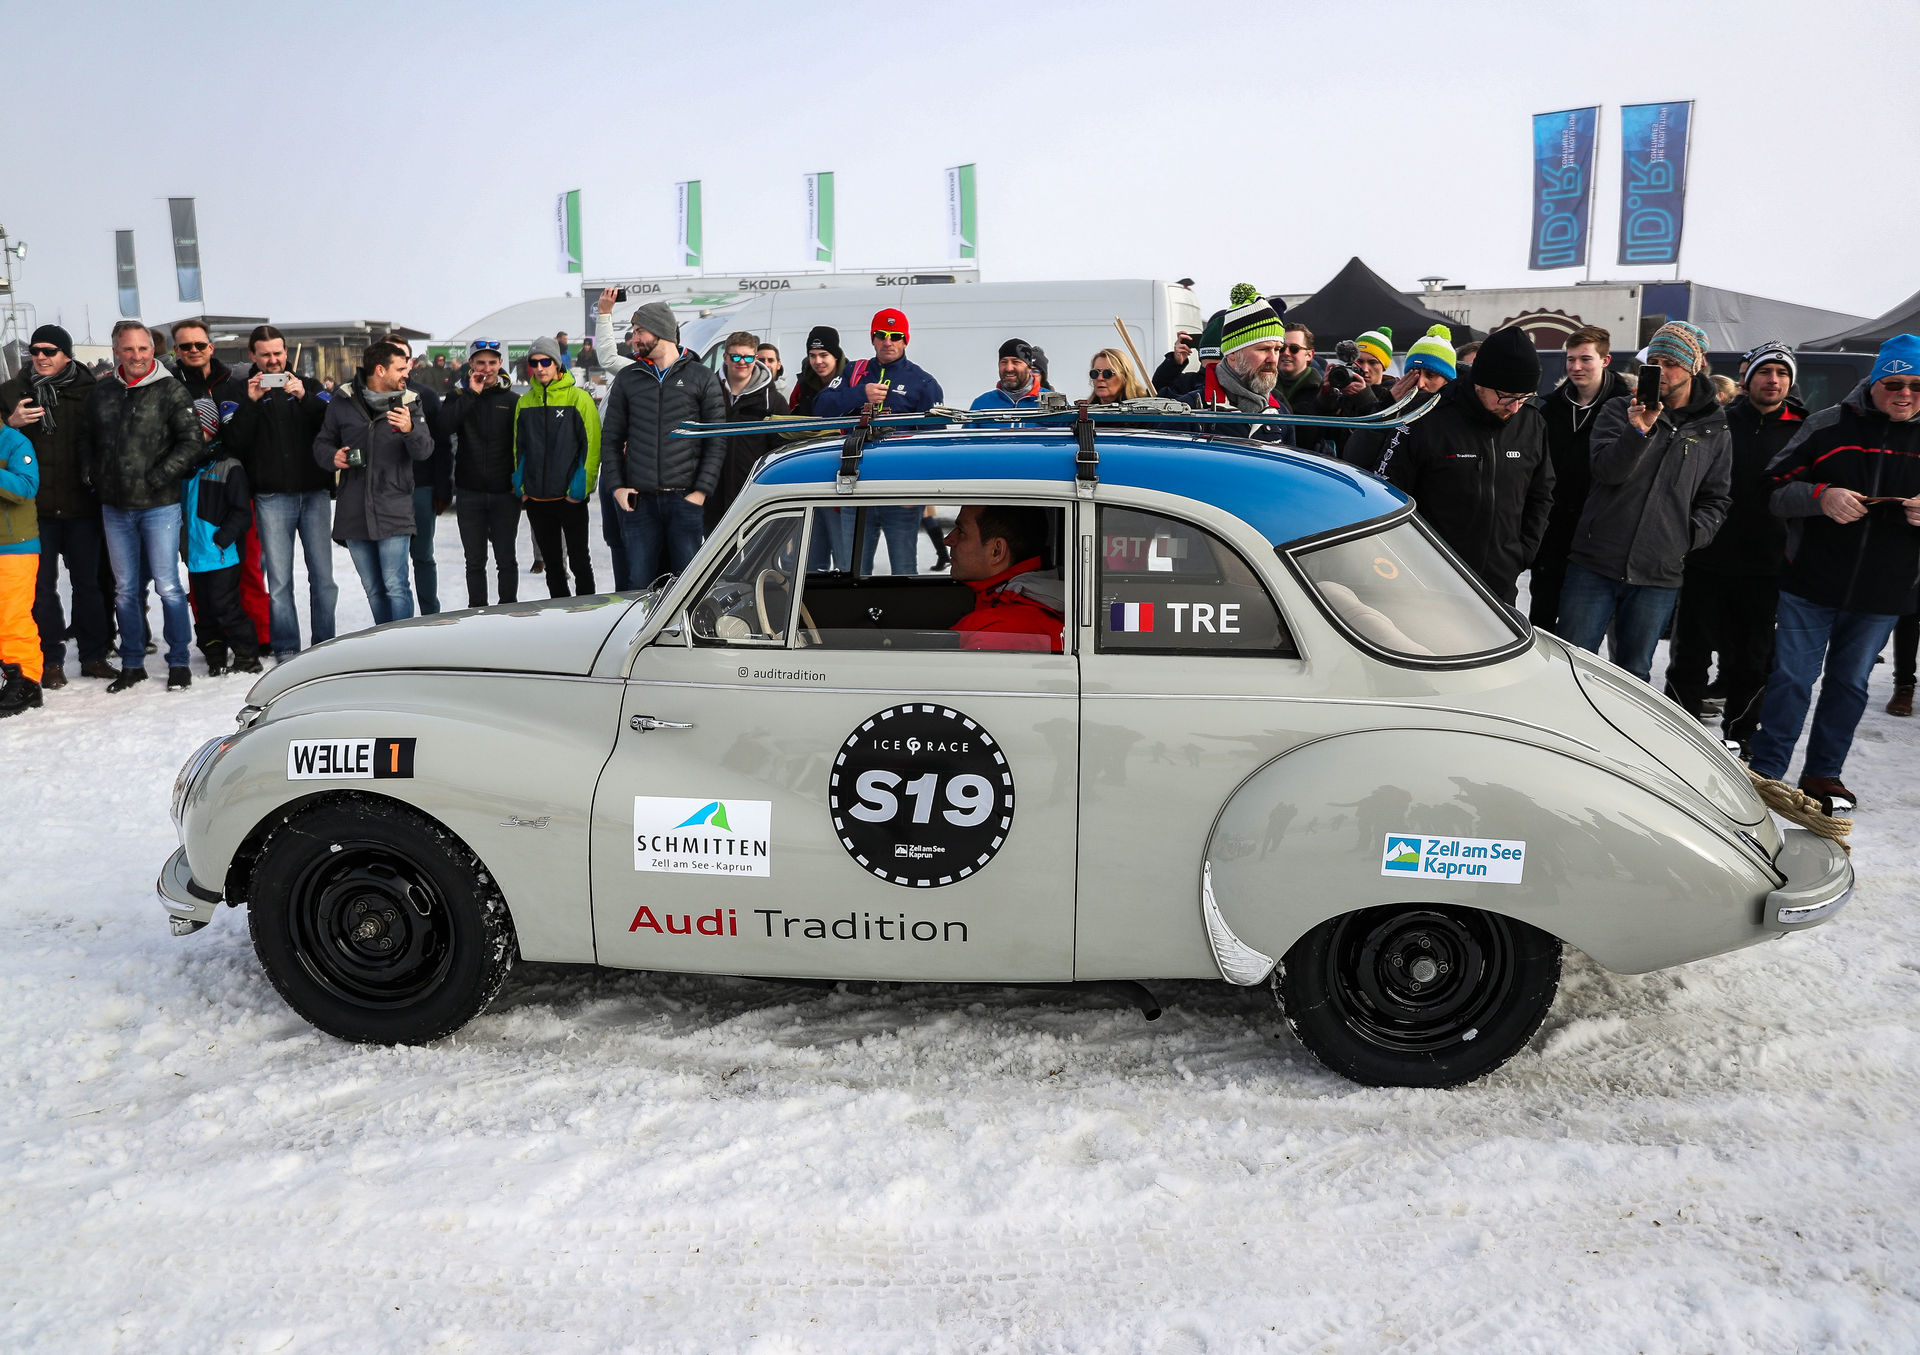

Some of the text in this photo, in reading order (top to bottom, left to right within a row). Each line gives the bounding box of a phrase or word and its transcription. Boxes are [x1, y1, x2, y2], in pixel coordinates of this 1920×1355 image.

[738, 278, 791, 291] ŠKODA
[876, 274, 918, 287] ŠKOD
[1166, 603, 1241, 633] TRE
[753, 666, 826, 682] auditradition
[873, 739, 901, 751] ICE
[927, 741, 969, 753] RACE
[389, 743, 400, 773] 1
[848, 769, 995, 828] S19
[637, 834, 767, 857] SCHMITTEN
[932, 845, 946, 853] See
[1426, 839, 1522, 861] Zell am See
[651, 858, 670, 868] Zell
[673, 860, 689, 869] am
[909, 851, 933, 860] Kaprun
[1424, 857, 1487, 879] Kaprun
[628, 905, 969, 943] Audi Tradition
